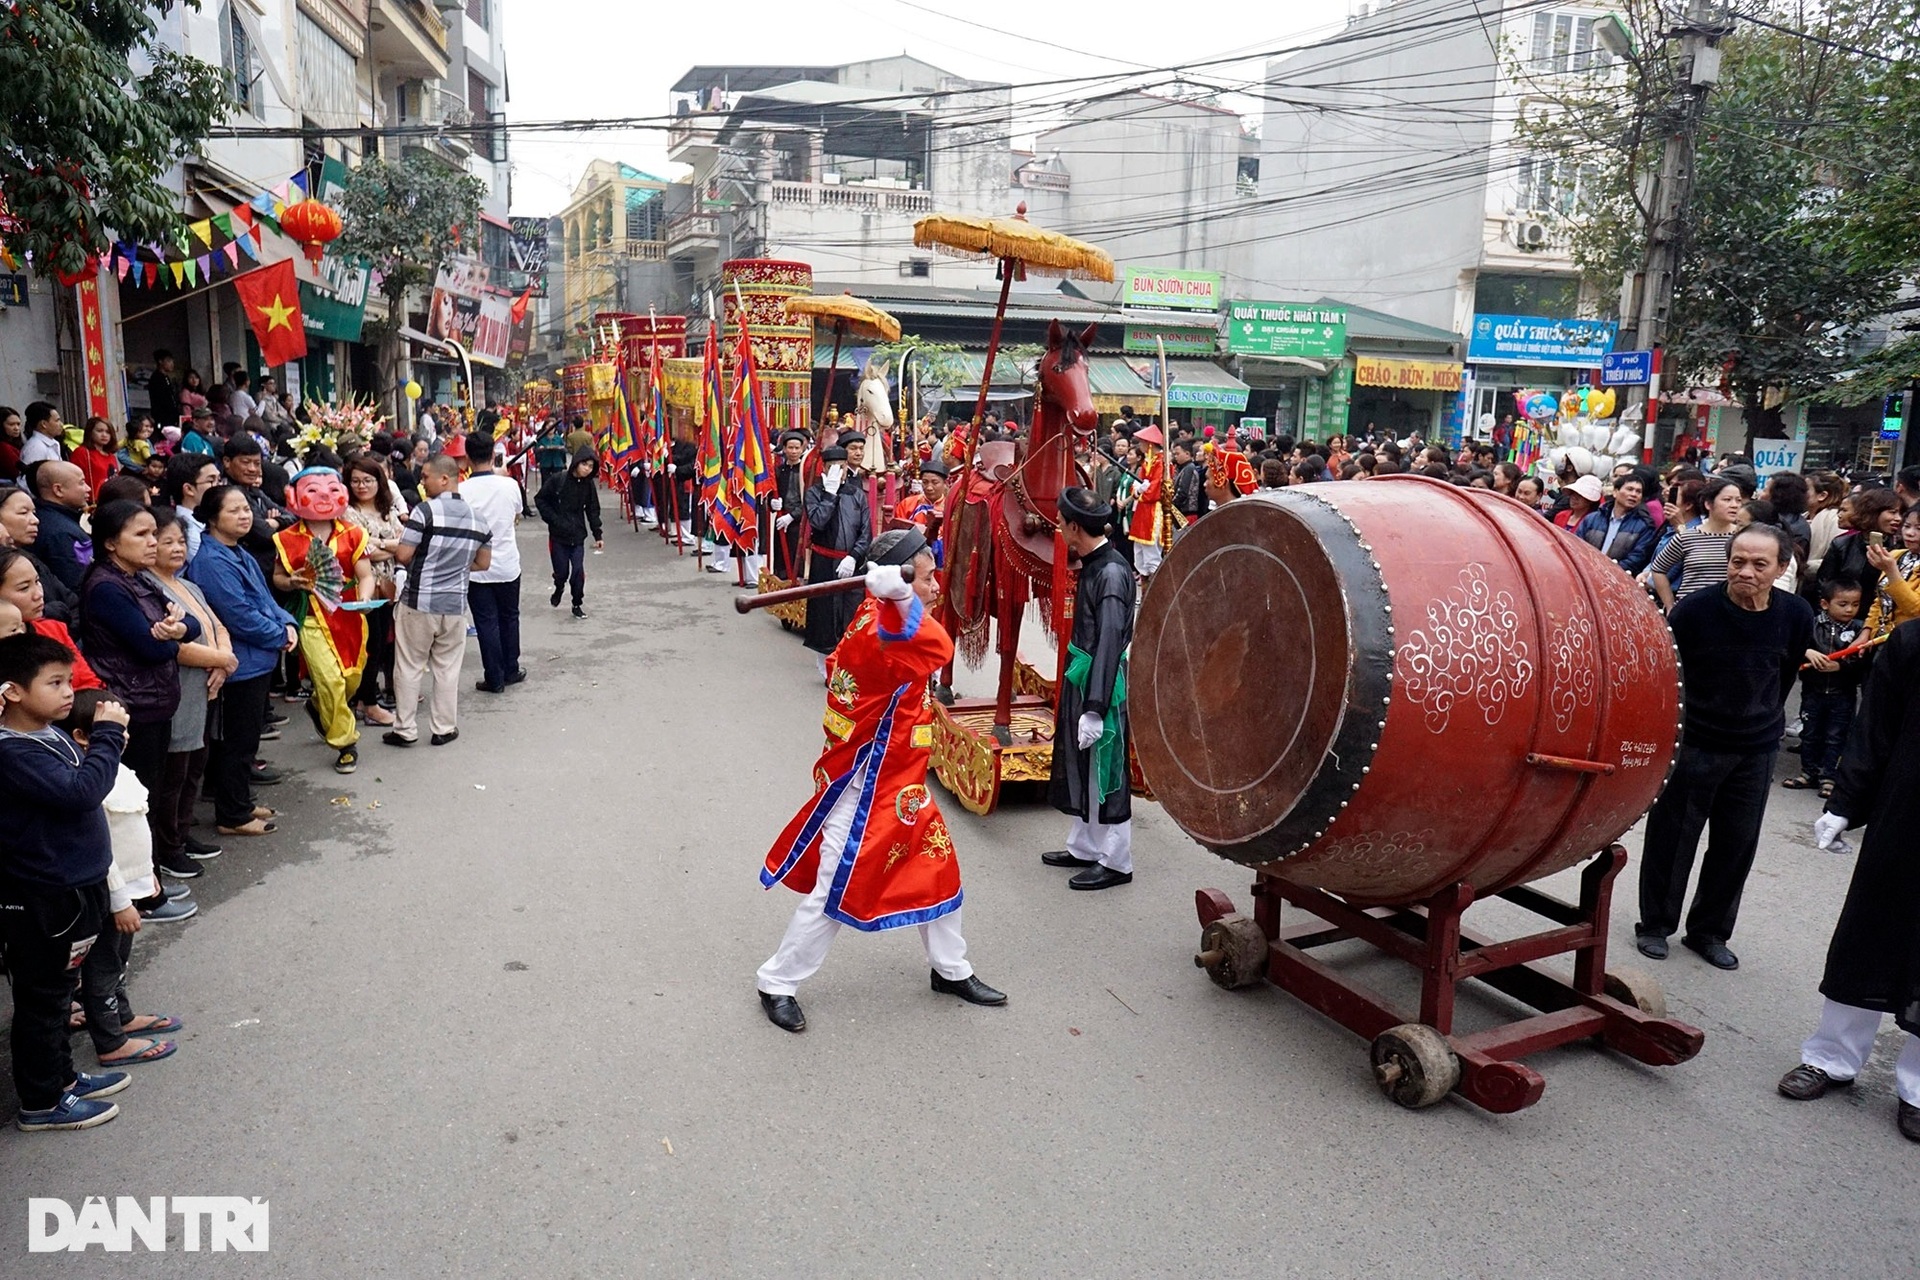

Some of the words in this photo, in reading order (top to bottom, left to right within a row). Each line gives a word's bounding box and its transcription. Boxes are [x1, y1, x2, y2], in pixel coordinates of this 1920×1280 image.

[511, 219, 545, 241] Coffee
[1133, 275, 1154, 292] BÚN
[1186, 281, 1212, 296] CHUA
[1260, 305, 1291, 322] THUỐC
[1293, 306, 1318, 323] NHẤT
[1341, 312, 1347, 325] 1
[1184, 333, 1210, 343] CHUA
[1358, 362, 1391, 384] CHÁO
[1399, 364, 1424, 386] BÚN
